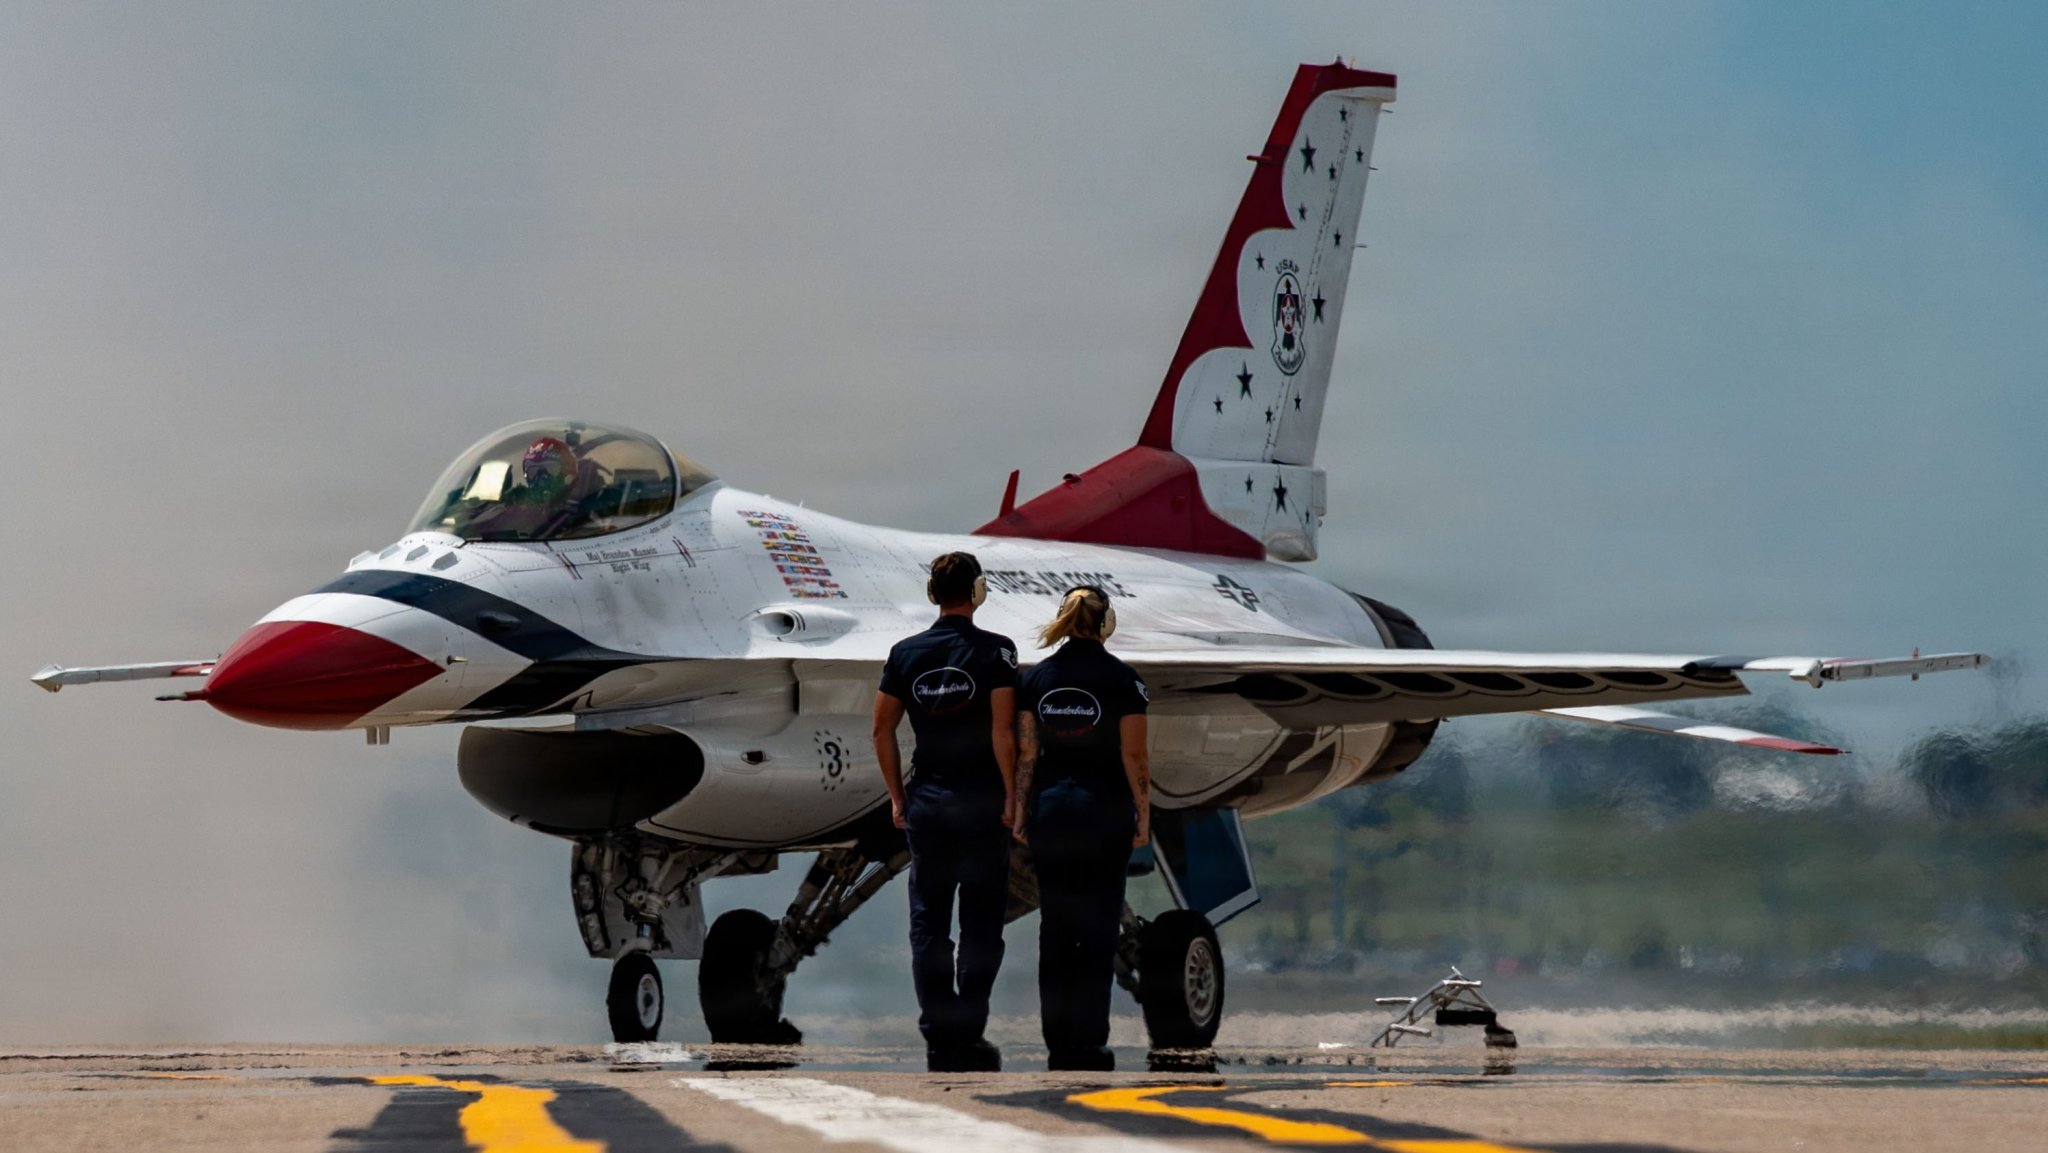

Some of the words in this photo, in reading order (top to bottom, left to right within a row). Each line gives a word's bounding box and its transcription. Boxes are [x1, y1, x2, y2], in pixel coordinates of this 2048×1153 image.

[917, 681, 970, 696] Thunderbirds
[1042, 704, 1096, 716] Thunderbirds
[824, 741, 843, 778] 3
